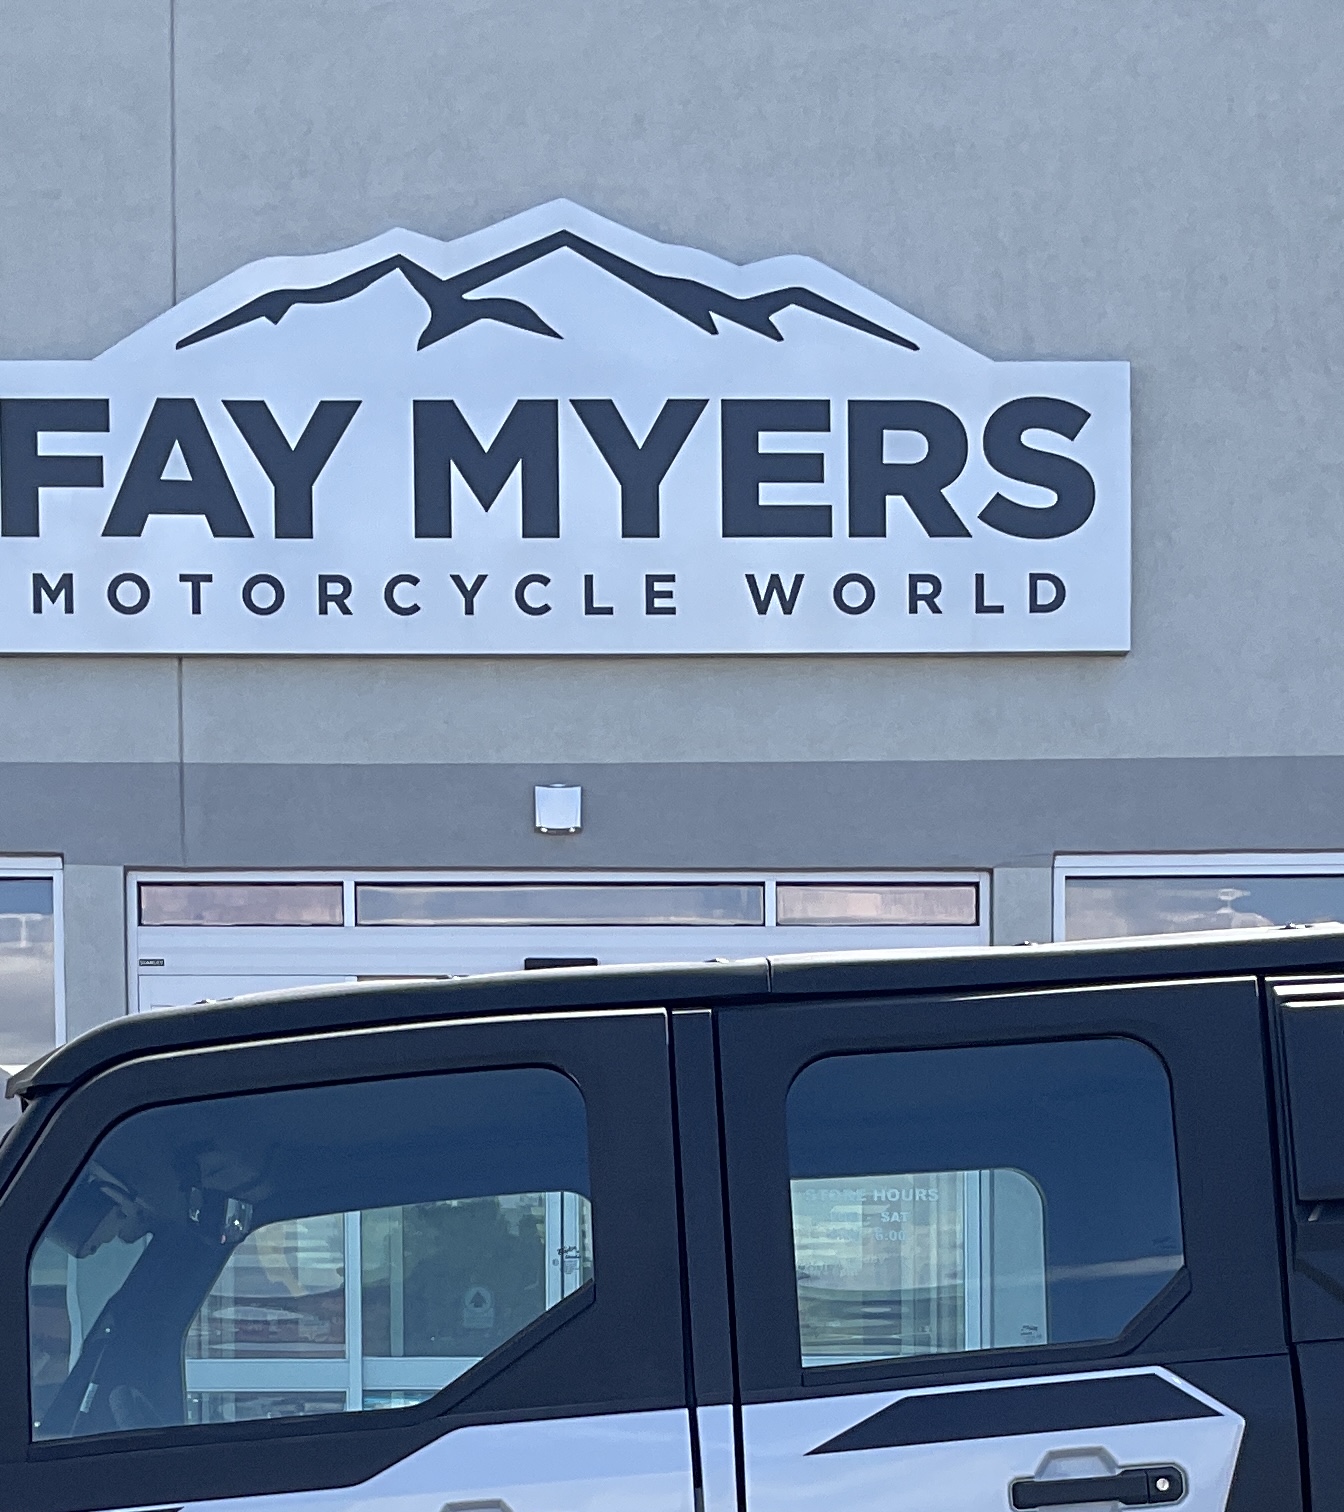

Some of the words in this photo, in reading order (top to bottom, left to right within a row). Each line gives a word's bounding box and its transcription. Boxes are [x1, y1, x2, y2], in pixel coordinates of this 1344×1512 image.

[412, 396, 1096, 540] MYERS
[31, 571, 677, 616] MOTORCYCLE
[745, 571, 1068, 616] WORLD
[873, 1188, 939, 1201] HOURS
[880, 1211, 909, 1223] SAT
